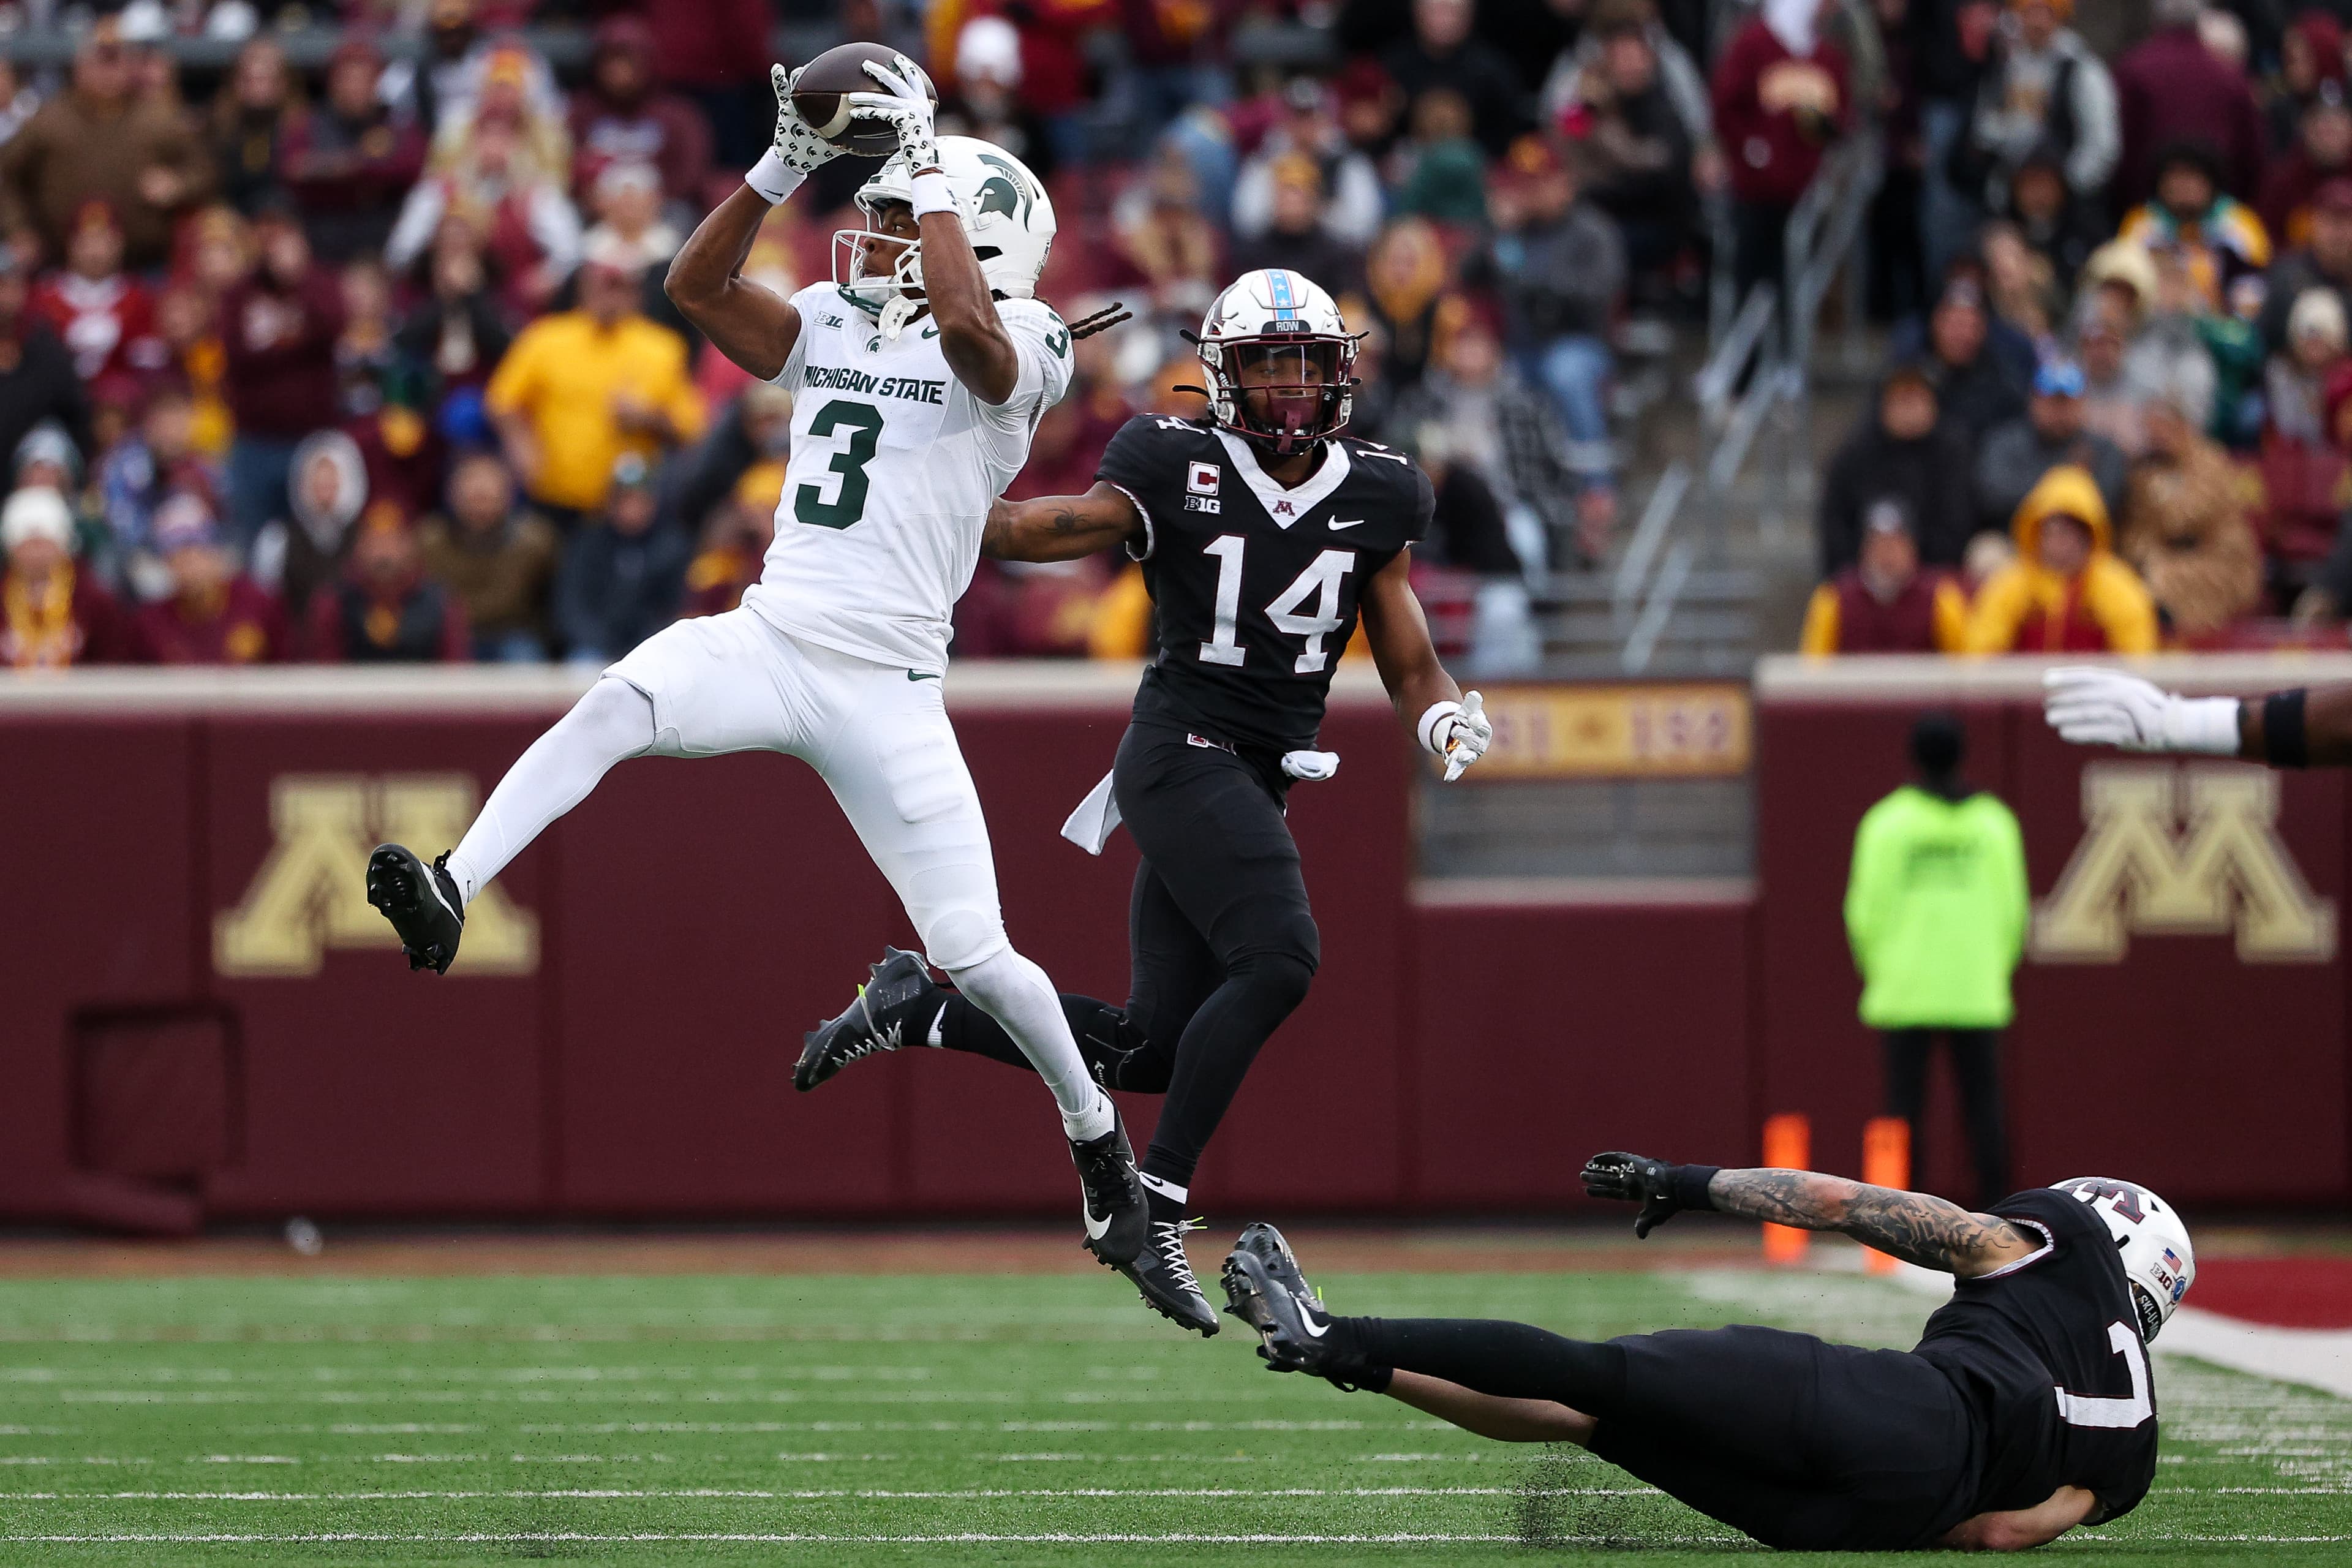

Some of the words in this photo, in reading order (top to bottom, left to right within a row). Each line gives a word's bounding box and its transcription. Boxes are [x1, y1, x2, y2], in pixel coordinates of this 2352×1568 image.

[1275, 322, 1299, 331] ROW
[804, 366, 880, 393] MICHIGAN
[878, 378, 946, 405] STATE
[794, 399, 884, 530] 3
[1189, 464, 1218, 494] C
[1198, 535, 1355, 674] 14
